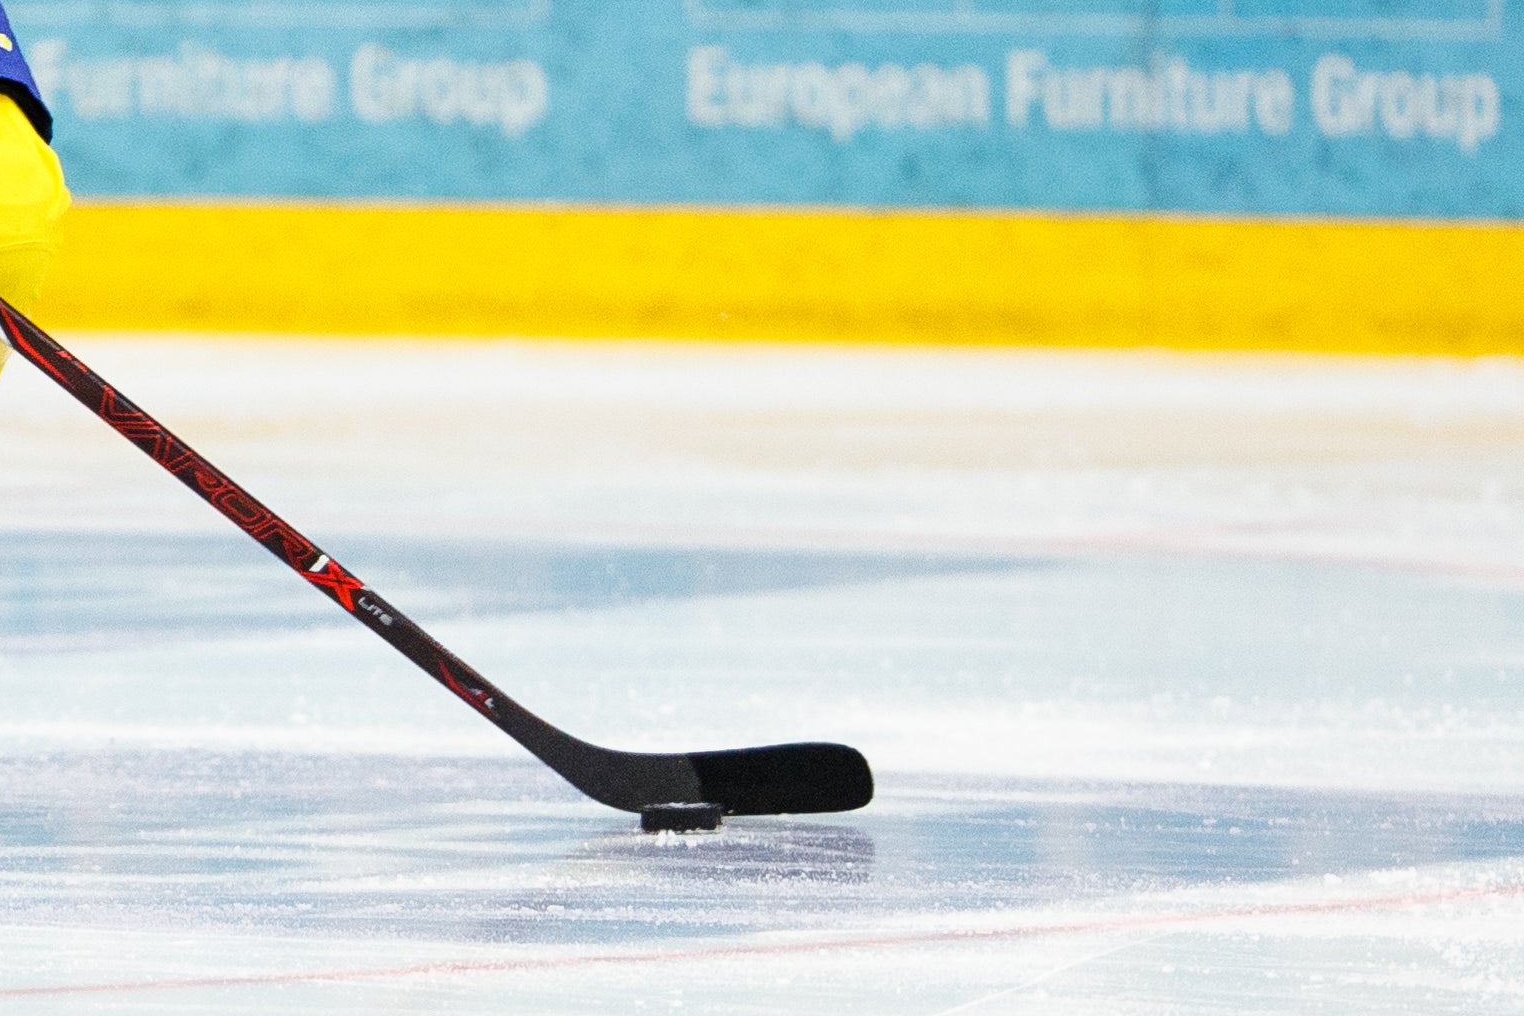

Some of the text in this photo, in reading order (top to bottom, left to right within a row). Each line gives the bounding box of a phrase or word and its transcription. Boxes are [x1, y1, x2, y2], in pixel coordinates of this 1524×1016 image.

[349, 41, 551, 140] Group
[684, 44, 1501, 156] European Furniture Group
